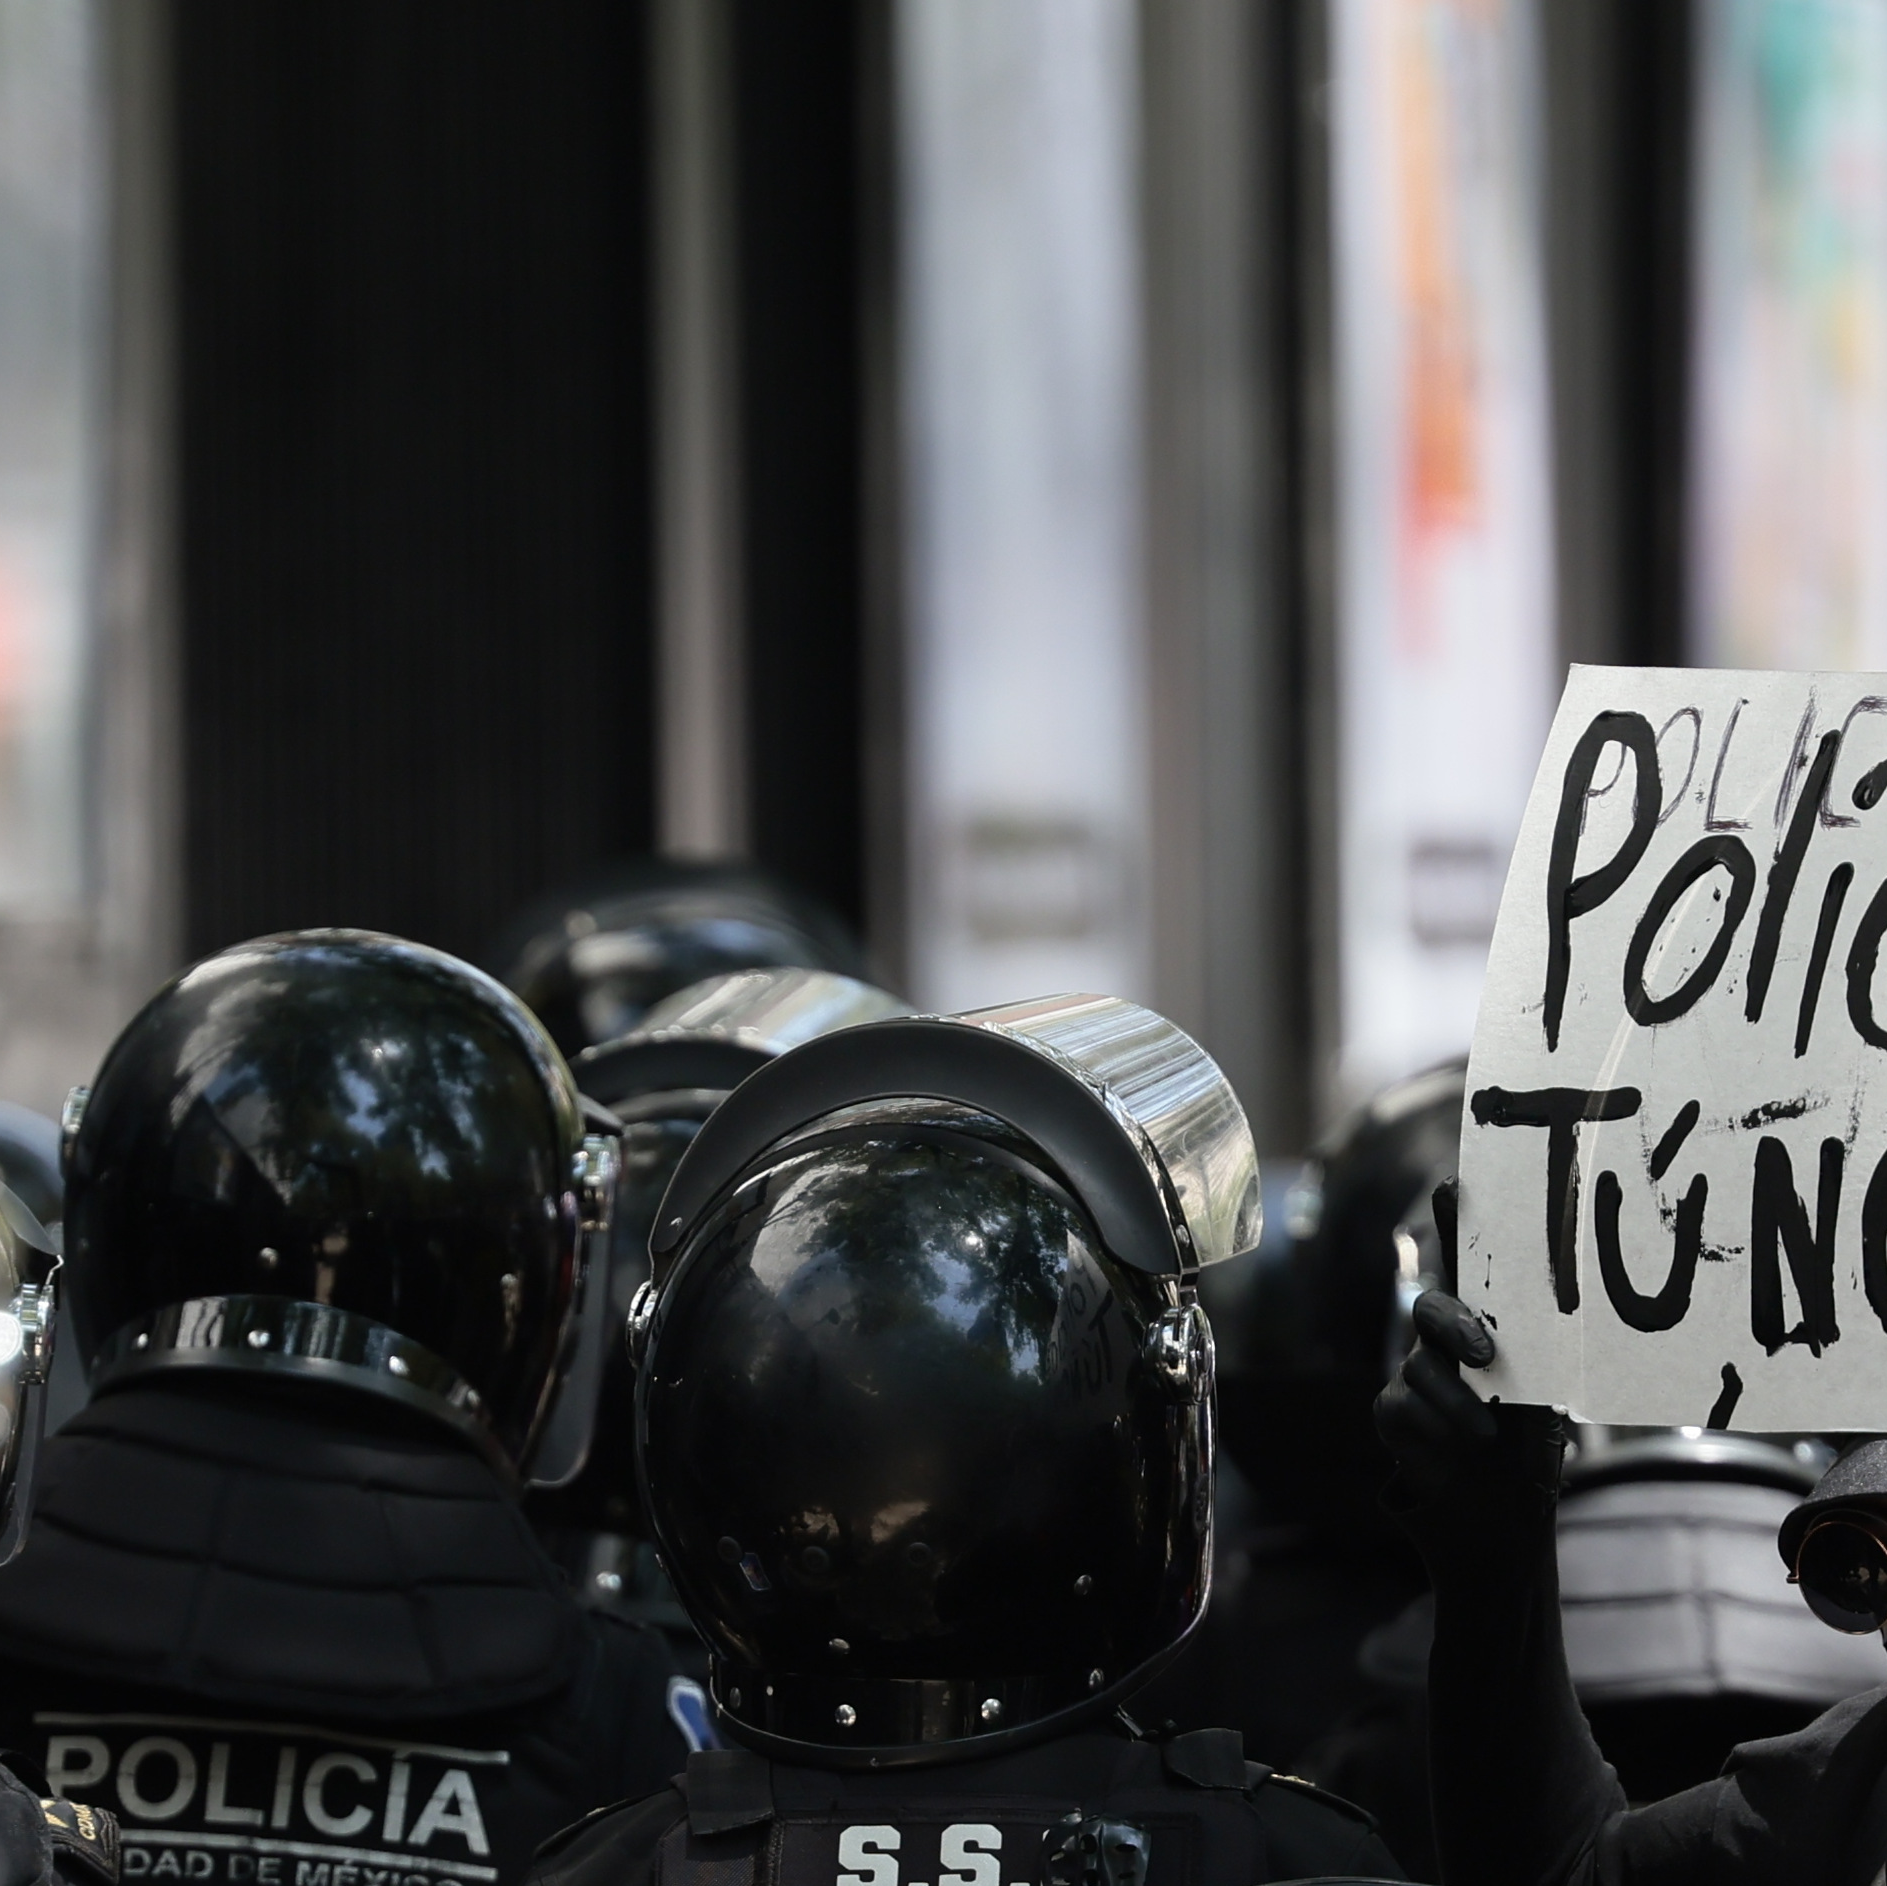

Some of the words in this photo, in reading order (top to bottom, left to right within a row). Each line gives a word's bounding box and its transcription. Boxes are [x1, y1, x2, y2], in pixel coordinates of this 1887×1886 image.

[1470, 1086, 1708, 1332] TÚ
[45, 1736, 490, 1855] POLICÍA
[229, 1853, 283, 1886] DE
